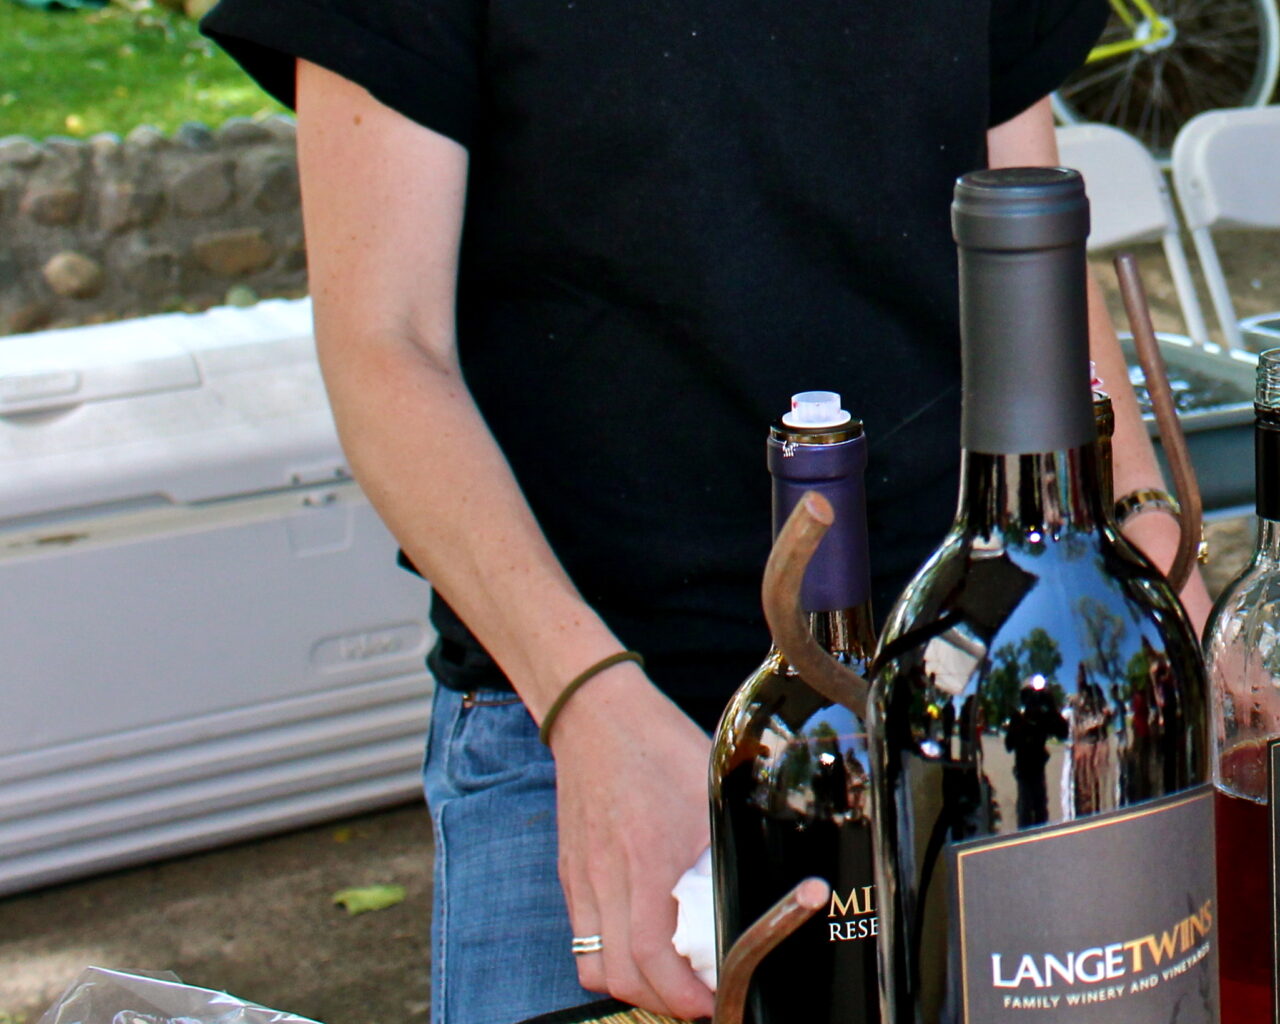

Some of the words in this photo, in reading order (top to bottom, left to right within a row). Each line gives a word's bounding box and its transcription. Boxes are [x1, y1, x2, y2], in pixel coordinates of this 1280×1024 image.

[828, 885, 875, 918] MI
[992, 899, 1214, 989] LANGETWINS
[1003, 994, 1060, 1009] FAMILY
[1066, 984, 1125, 1006] WINERY
[1130, 975, 1159, 994] AND
[1162, 941, 1211, 981] VINEYARDS
